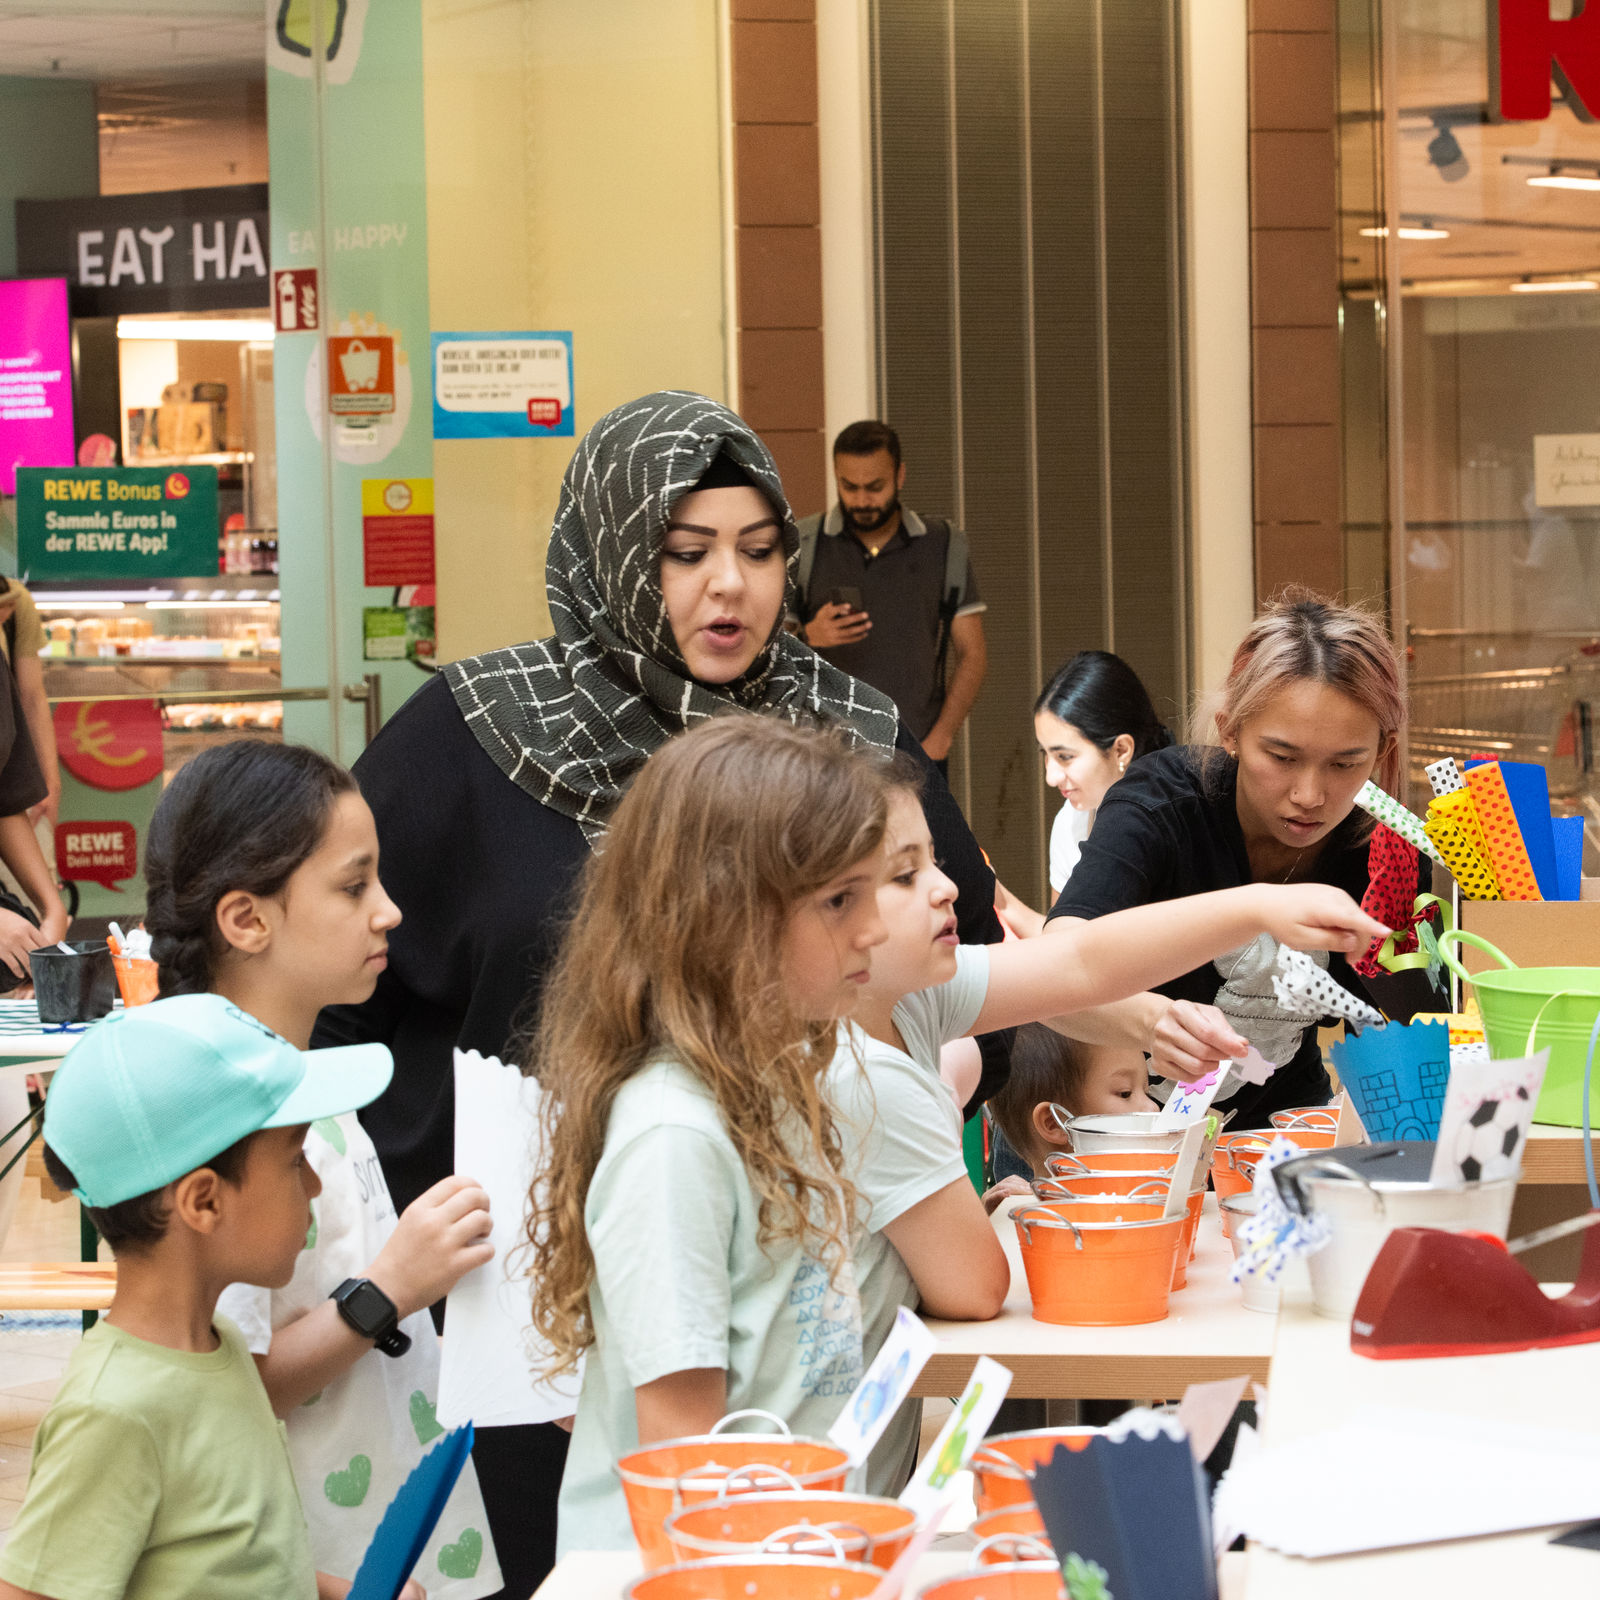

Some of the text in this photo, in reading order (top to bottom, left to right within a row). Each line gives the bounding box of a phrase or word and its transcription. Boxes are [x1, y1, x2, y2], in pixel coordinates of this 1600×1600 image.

[288, 223, 408, 254] EA HAPPY
[43, 479, 162, 500] REWE Bonus
[45, 509, 177, 530] Sammle Euros in
[45, 532, 169, 555] der REWE App!
[66, 832, 124, 853] REWE
[1173, 1097, 1192, 1114] 1x
